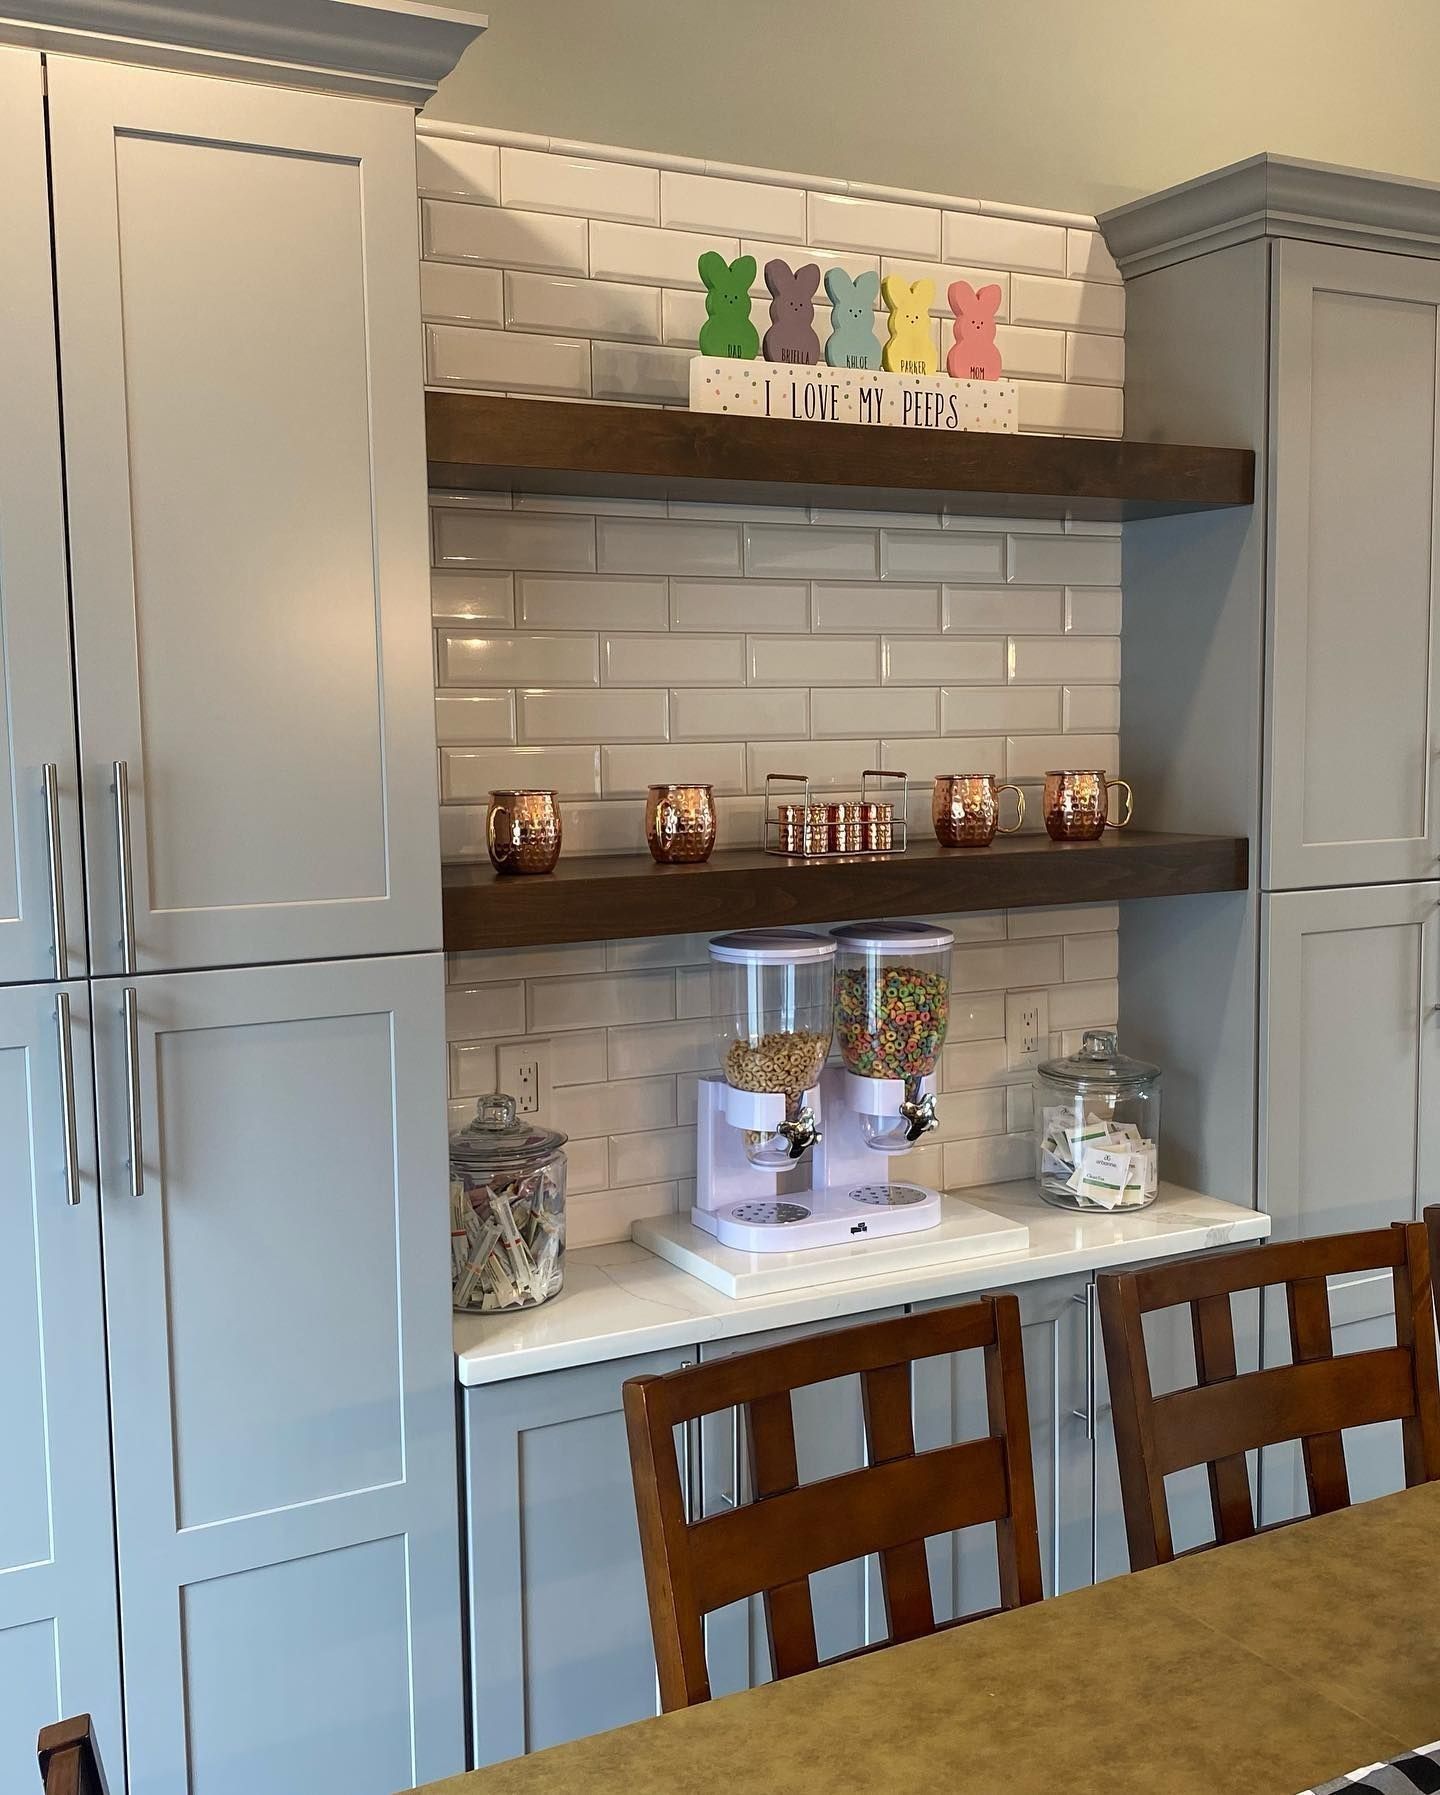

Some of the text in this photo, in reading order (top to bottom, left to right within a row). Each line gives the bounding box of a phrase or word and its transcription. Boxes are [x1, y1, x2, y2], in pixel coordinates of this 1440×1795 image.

[727, 344, 742, 359] DAD
[781, 348, 810, 366] BRIELLA
[846, 354, 869, 370] KHLOE
[900, 359, 927, 376] PARKER
[970, 366, 985, 380] MOM
[764, 380, 959, 429] I LOVE MY PEEPS
